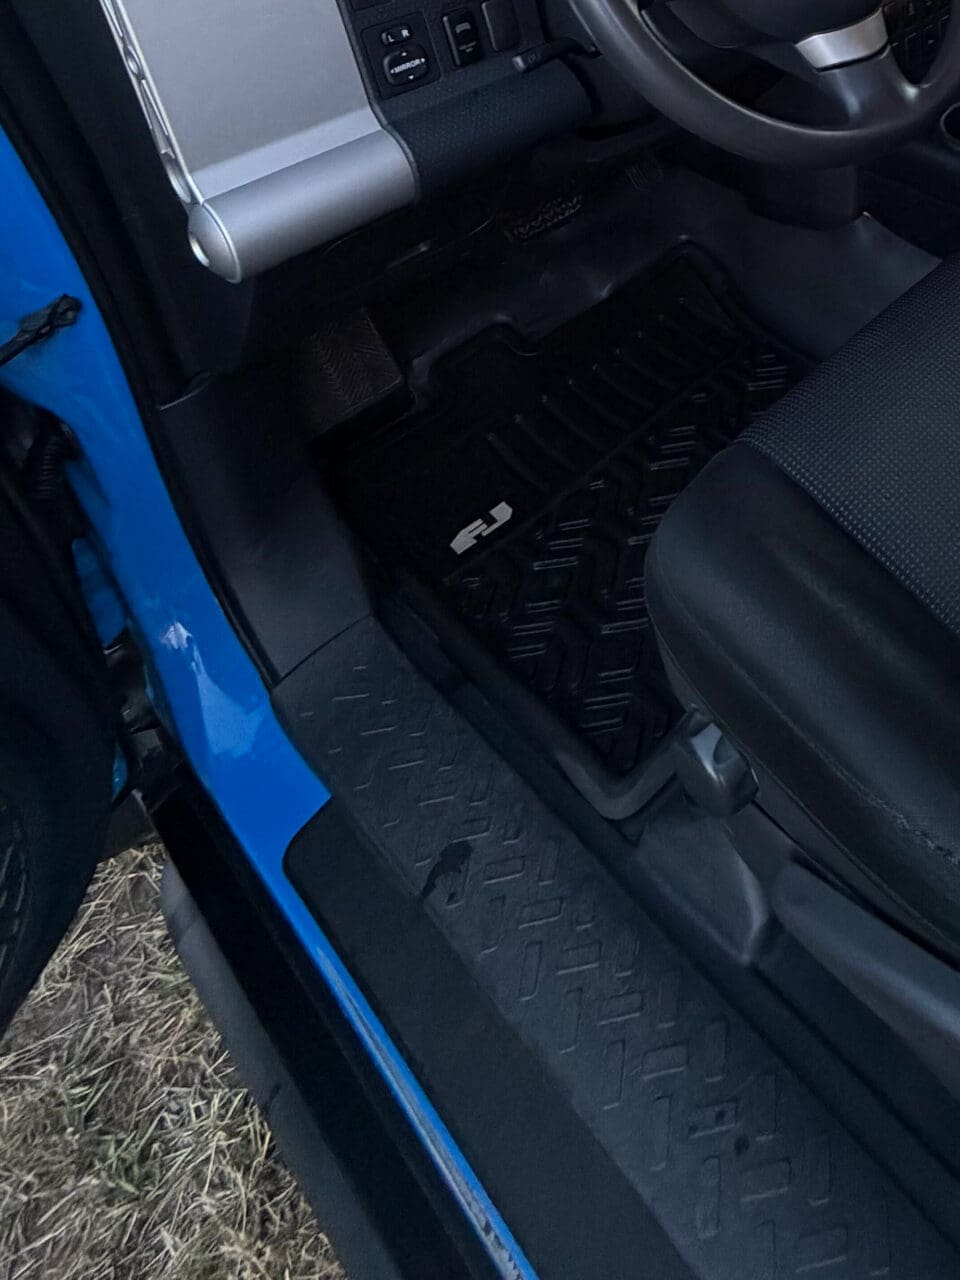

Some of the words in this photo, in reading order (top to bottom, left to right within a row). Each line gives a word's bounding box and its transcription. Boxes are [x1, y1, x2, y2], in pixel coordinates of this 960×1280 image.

[387, 34, 395, 43] L
[401, 29, 410, 38] R
[394, 58, 421, 74] MIRROR
